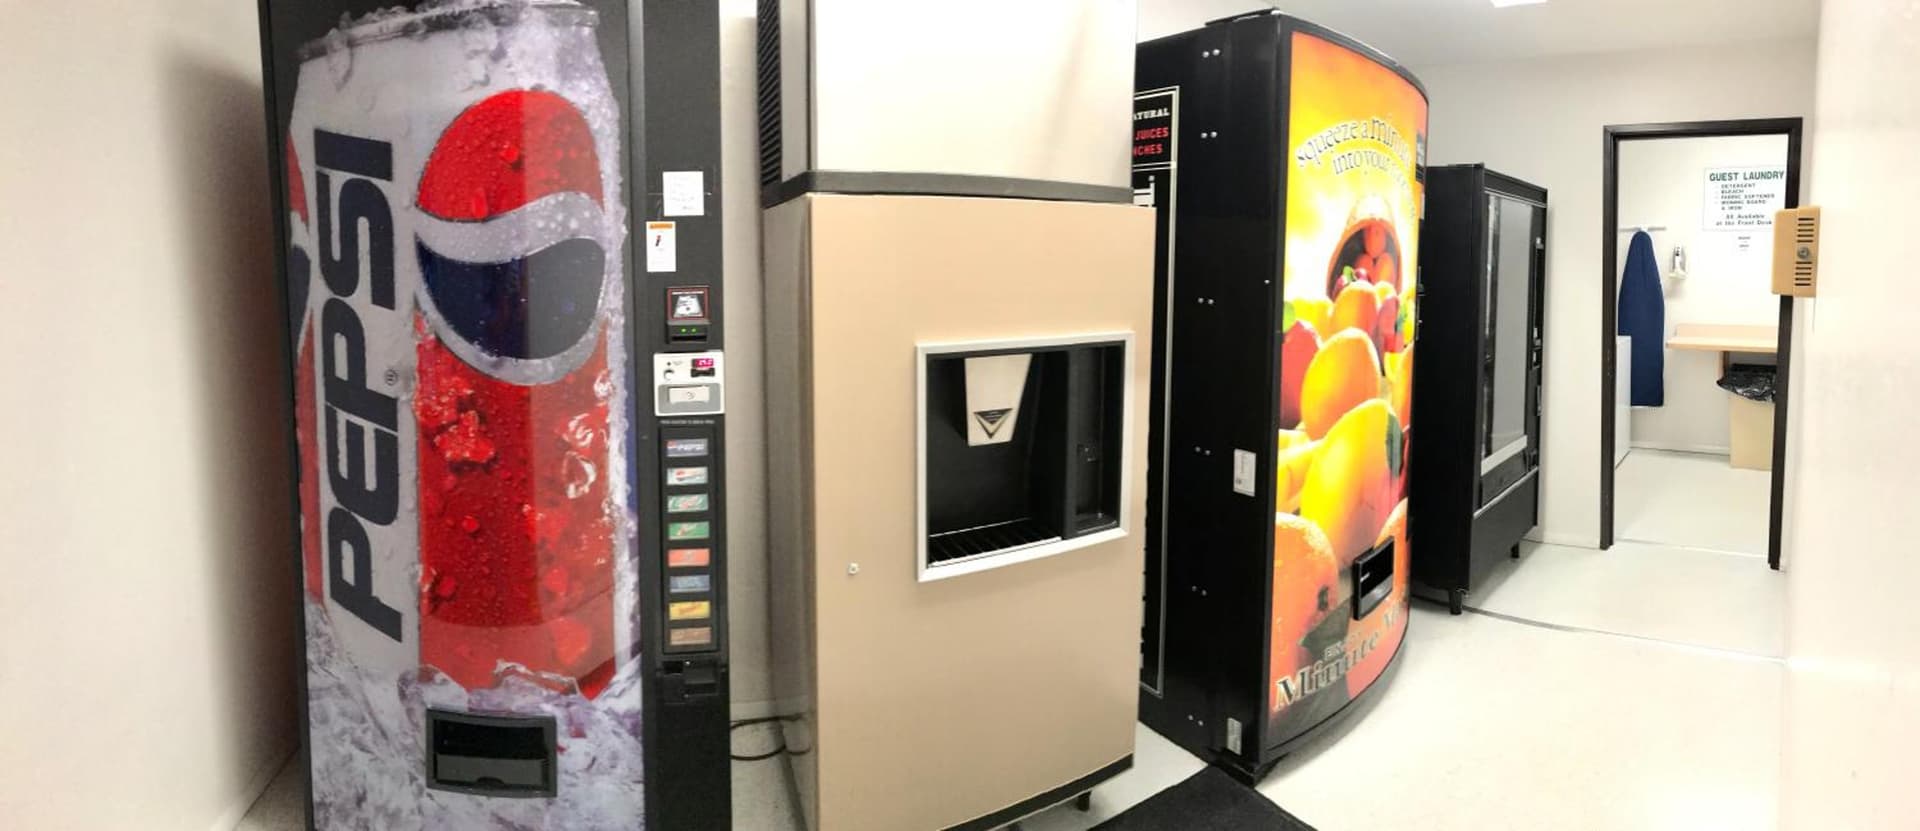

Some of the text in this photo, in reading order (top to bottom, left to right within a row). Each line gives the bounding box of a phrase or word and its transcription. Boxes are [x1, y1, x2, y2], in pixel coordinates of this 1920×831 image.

[1136, 127, 1169, 140] JUICES
[1297, 122, 1359, 167] squeeze
[1361, 122, 1369, 139] a
[1333, 150, 1362, 175] into
[1709, 170, 1785, 182] GUEST LAUNDRY
[314, 128, 403, 643] PEPSI
[1273, 632, 1380, 712] Minute
